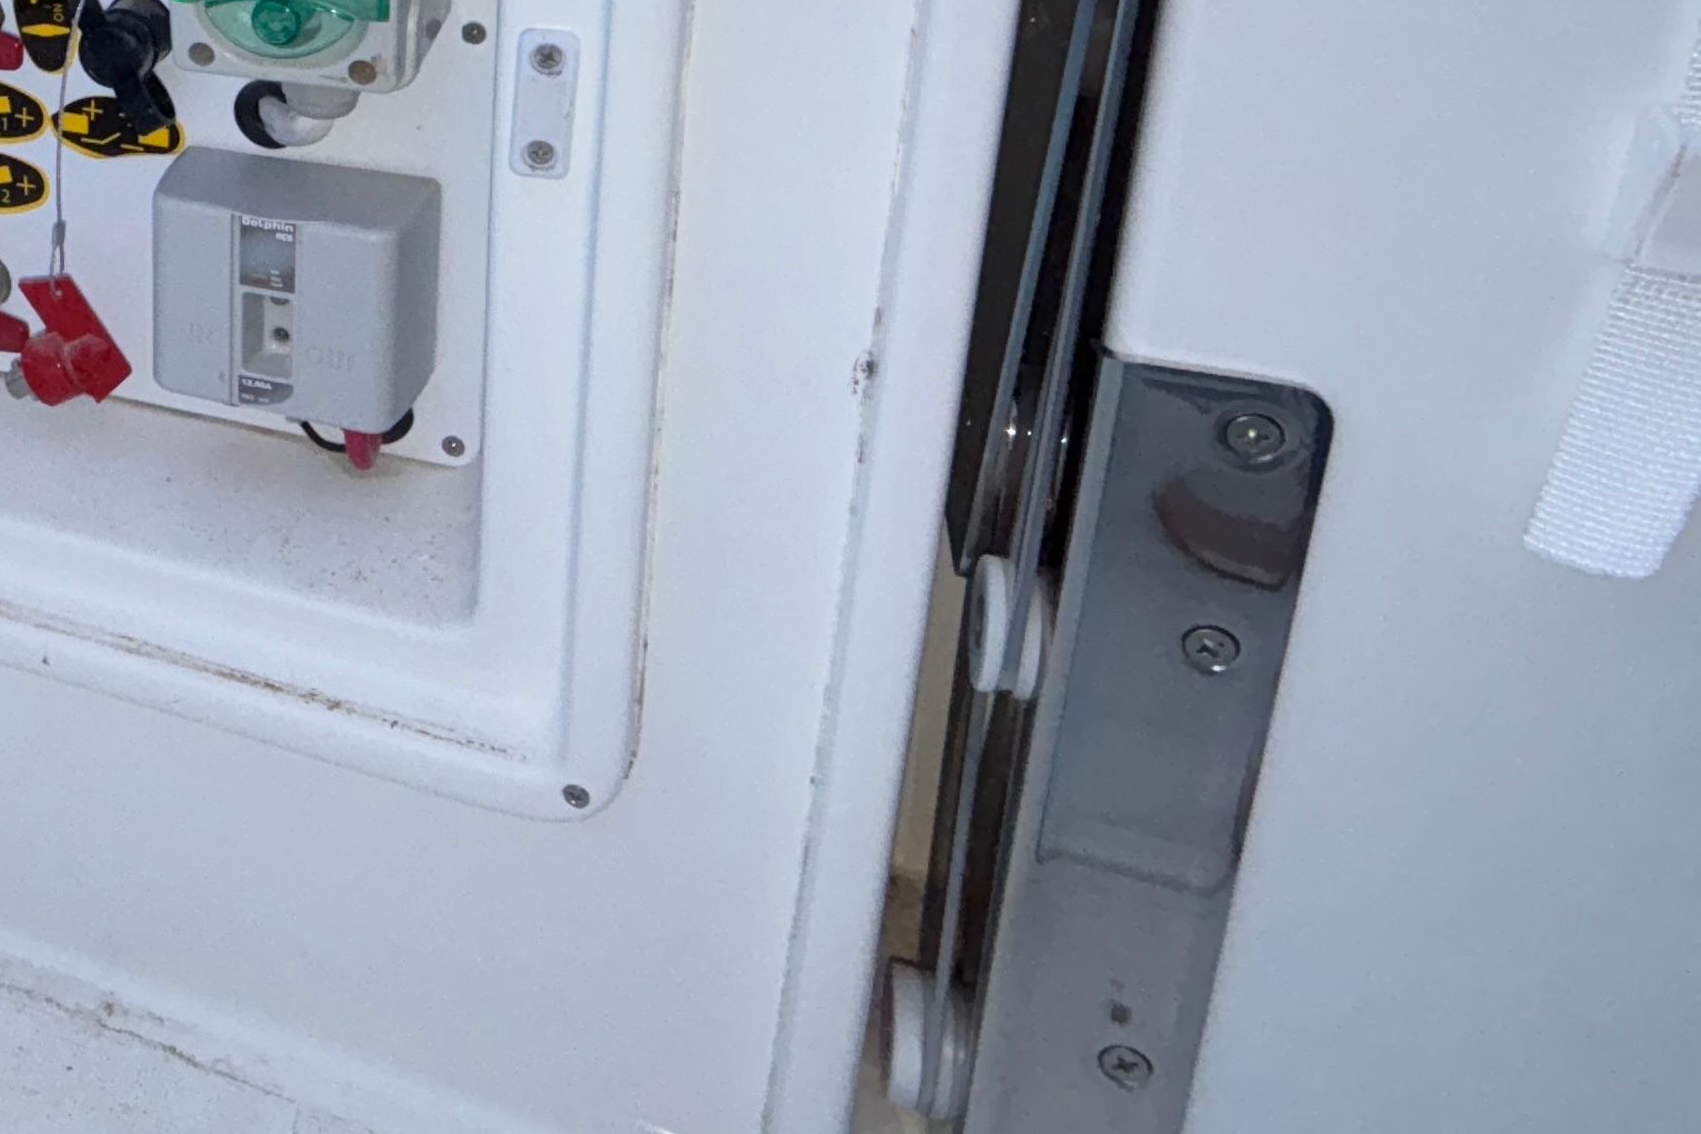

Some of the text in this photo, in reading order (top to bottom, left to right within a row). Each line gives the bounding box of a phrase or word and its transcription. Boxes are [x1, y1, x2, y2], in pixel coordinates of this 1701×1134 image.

[53, 3, 64, 22] ON
[1, 117, 8, 131] 1
[1, 189, 11, 203] 2
[242, 215, 294, 232] Dolphin
